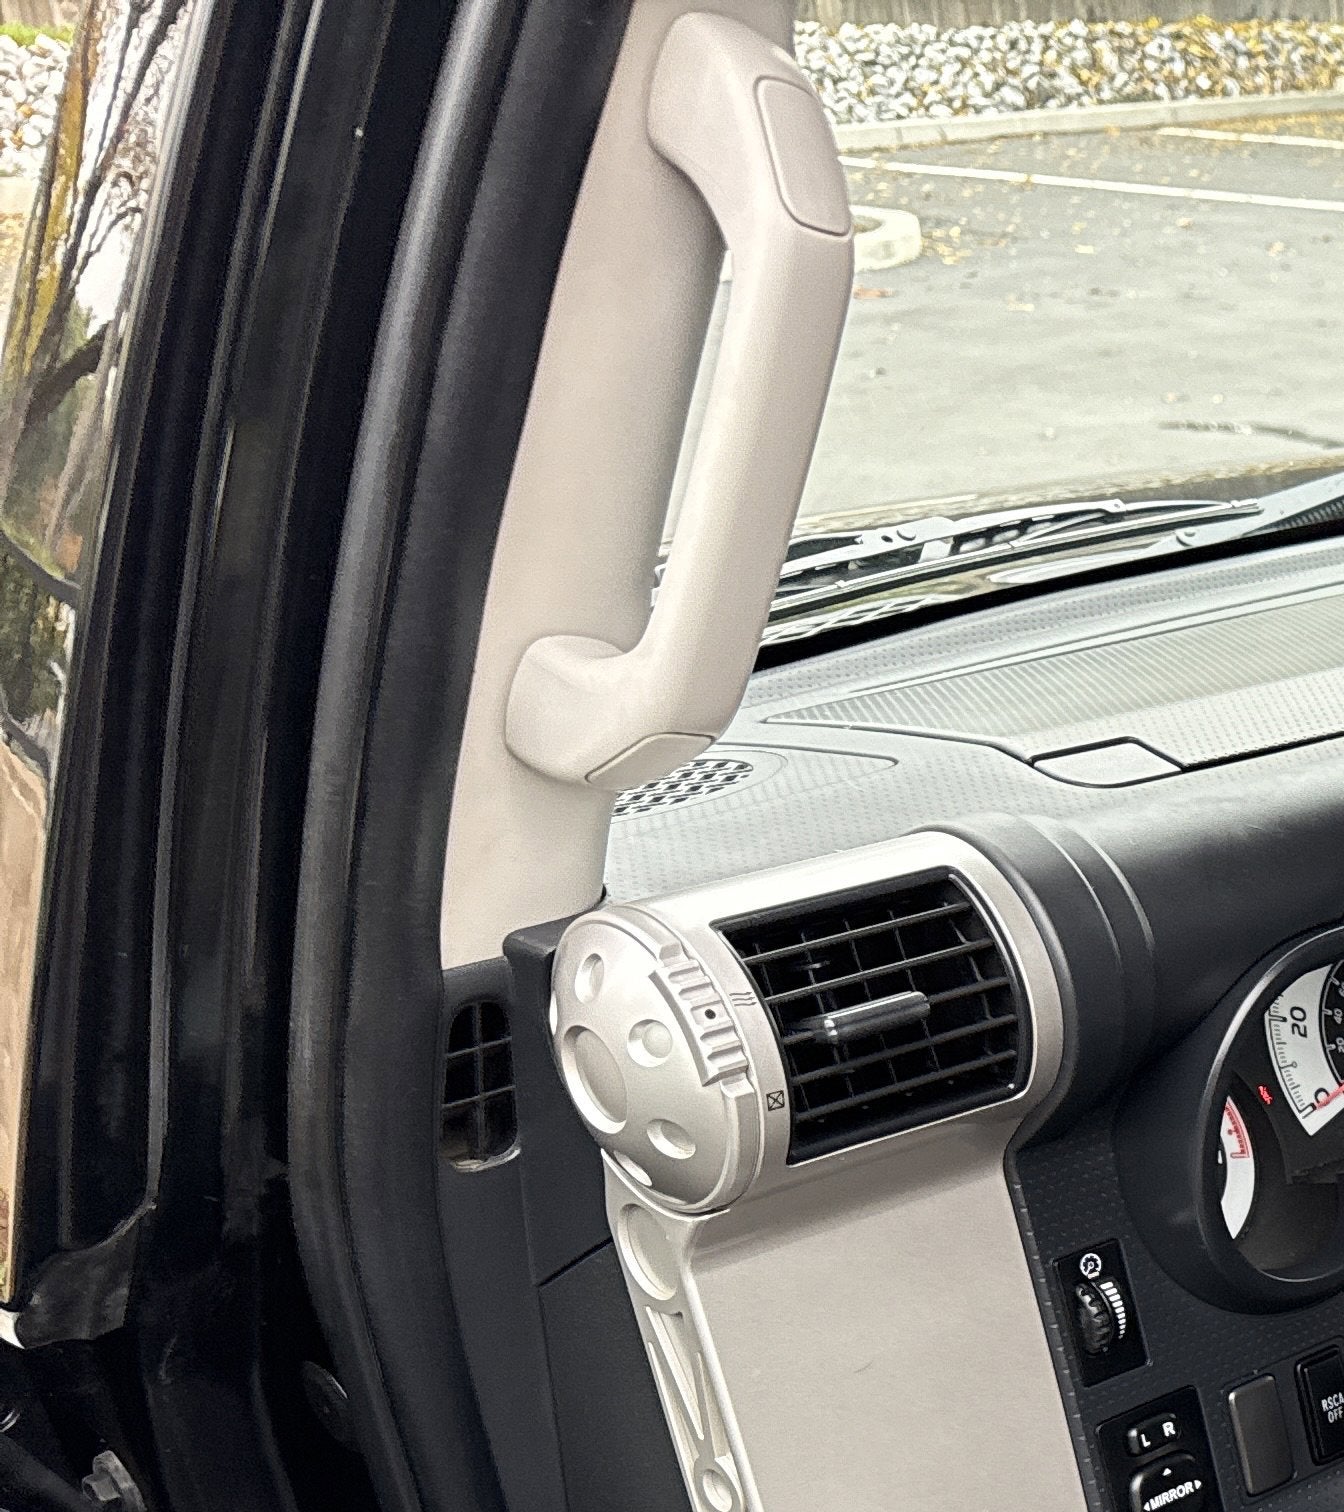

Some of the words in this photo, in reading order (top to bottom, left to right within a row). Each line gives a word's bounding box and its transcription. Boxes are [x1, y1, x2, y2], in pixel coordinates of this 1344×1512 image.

[1290, 1006, 1308, 1039] 20
[1327, 1405, 1344, 1424] OFF
[1140, 1433, 1151, 1448] L
[1163, 1421, 1177, 1437] R
[1149, 1480, 1195, 1510] MIRROR
